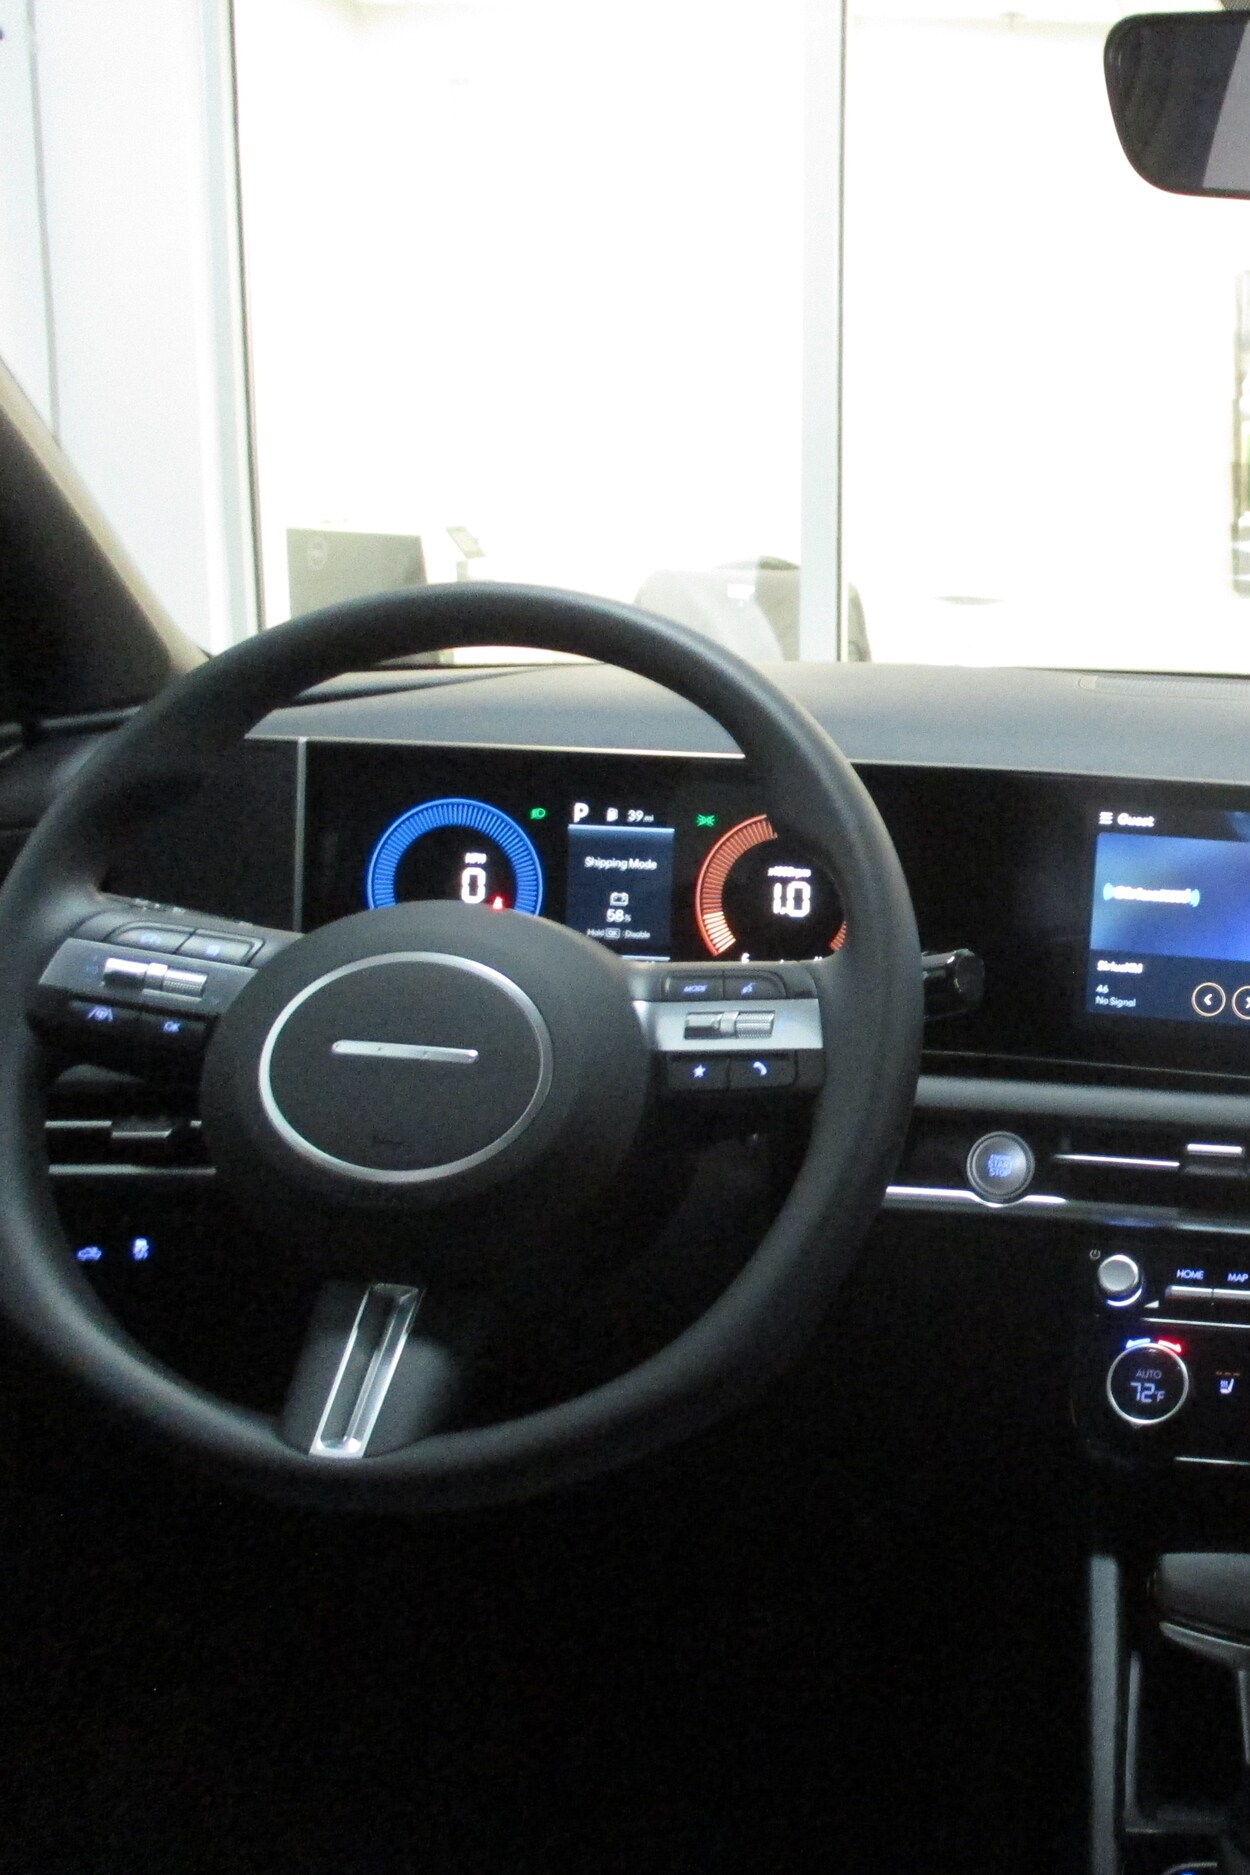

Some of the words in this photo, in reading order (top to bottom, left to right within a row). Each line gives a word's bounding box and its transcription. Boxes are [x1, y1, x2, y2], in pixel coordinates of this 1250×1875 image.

[584, 856, 628, 871] Shipping
[628, 858, 658, 870] Mode
[461, 866, 486, 904] 0
[773, 880, 811, 918] 1.0
[682, 984, 708, 993] MODE
[1095, 995, 1108, 1006] No
[1109, 996, 1136, 1008] Signal
[1176, 1269, 1204, 1280] HOME
[1227, 1272, 1249, 1282] MAP
[1136, 1369, 1162, 1380] AUTO
